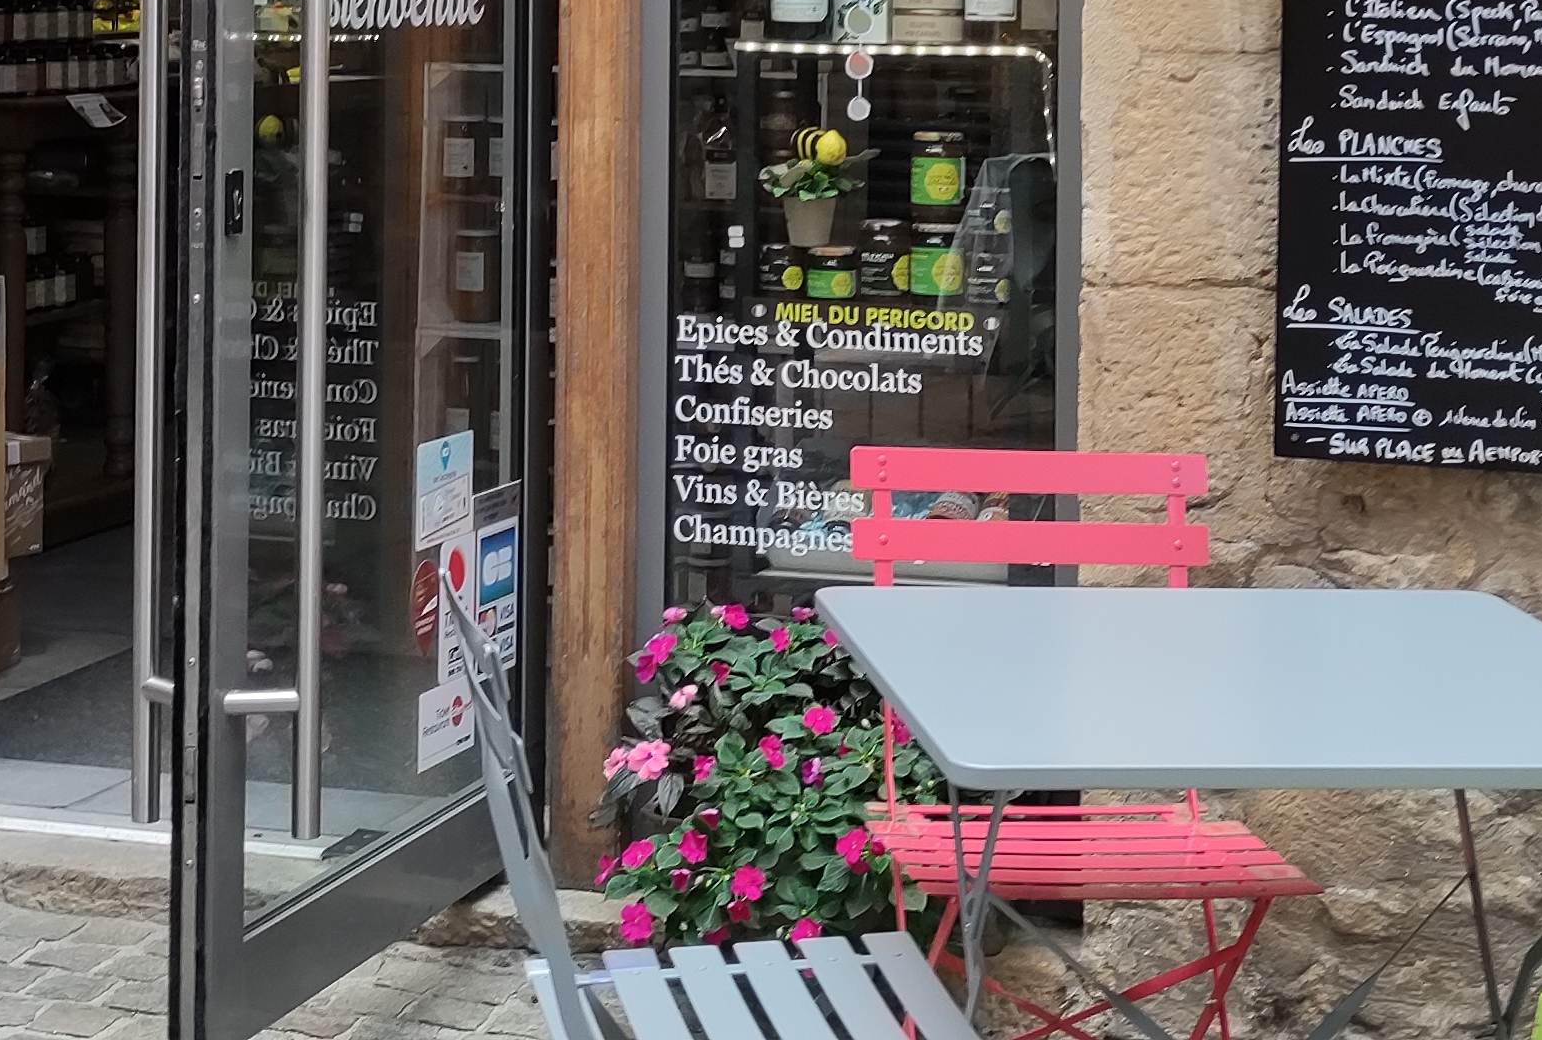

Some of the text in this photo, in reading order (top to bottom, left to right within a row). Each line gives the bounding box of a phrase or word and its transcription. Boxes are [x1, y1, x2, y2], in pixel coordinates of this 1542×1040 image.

[1340, 49, 1431, 78] Sandwich
[1449, 55, 1481, 78] du
[1338, 83, 1426, 111] Sandwich
[1287, 115, 1444, 159] Les PLANCHES
[774, 302, 975, 332] MIEL DU PERIGORD
[1282, 283, 1414, 329] Les SALADES
[675, 314, 984, 357] Epices & Condiments
[674, 353, 923, 394] Thés & Chocolats
[1281, 369, 1410, 402] Assiette APERO
[674, 394, 834, 430] Confiseries
[1285, 401, 1351, 423] Assiette
[1356, 404, 1408, 424] APERO
[674, 434, 804, 473] Foie gras
[1328, 432, 1371, 456] SUR
[1375, 437, 1436, 460] PLACE
[672, 473, 866, 512] Vins & Bières
[672, 513, 854, 557] Champagnes
